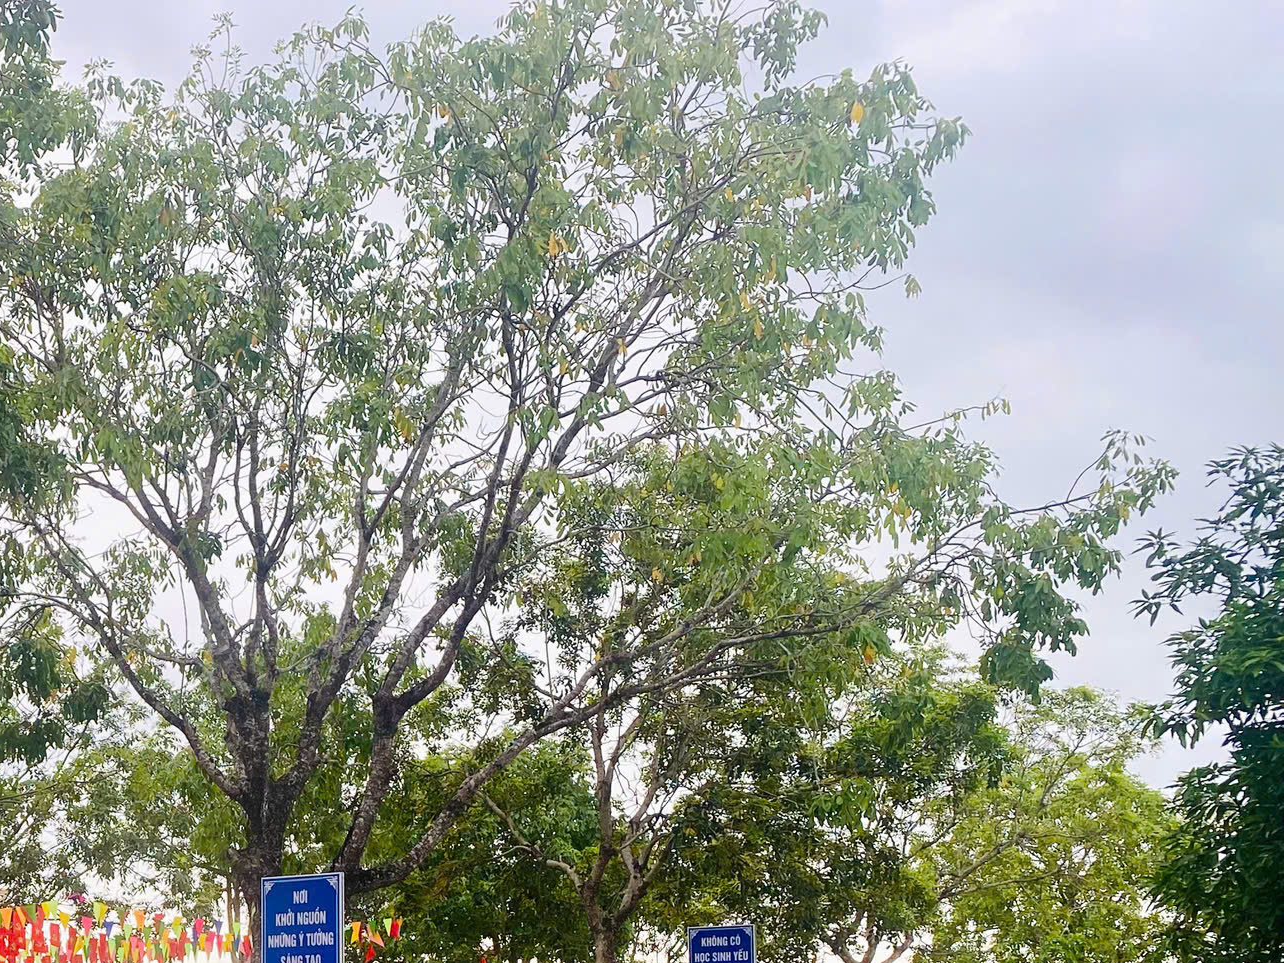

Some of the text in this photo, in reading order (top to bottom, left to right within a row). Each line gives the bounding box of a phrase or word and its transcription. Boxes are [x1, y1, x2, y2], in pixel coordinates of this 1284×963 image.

[293, 889, 308, 904] NƠI
[276, 908, 295, 926] KHỞI
[268, 928, 334, 948] NHỮNG Ý TƯỞNG
[701, 934, 741, 947] KHÔNG CÓ
[694, 948, 748, 963] HỌC SINH YẾU
